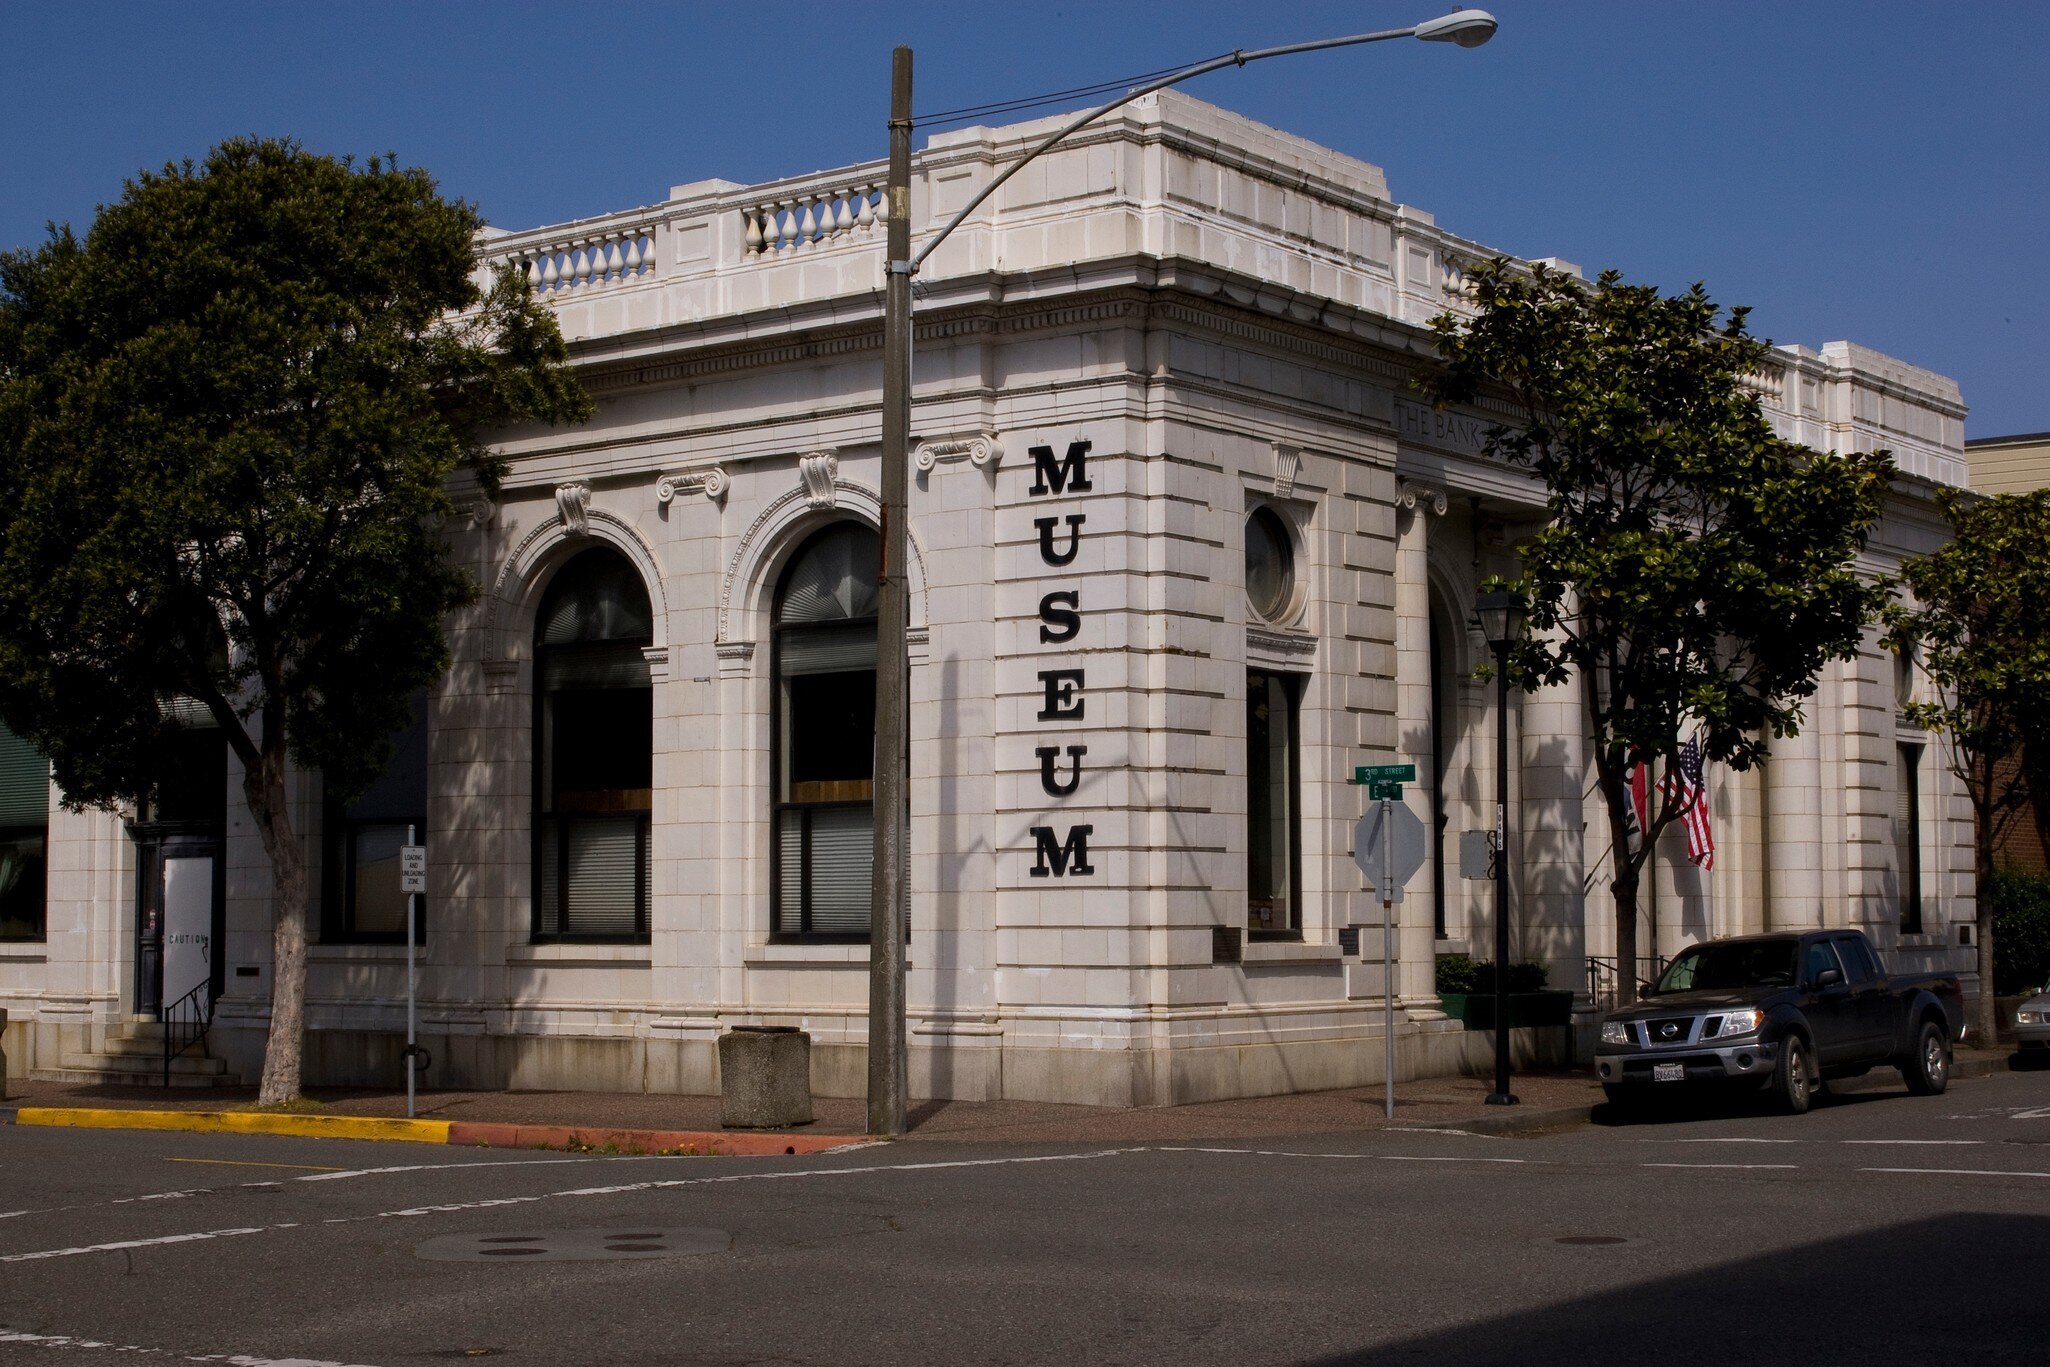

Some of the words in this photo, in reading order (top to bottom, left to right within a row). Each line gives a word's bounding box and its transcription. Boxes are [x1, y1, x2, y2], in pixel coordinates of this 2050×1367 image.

[1394, 403, 1429, 435] THE
[1436, 413, 1480, 448] BANK
[1029, 440, 1094, 878] MUSEUM
[1384, 767, 1405, 775] STREET
[169, 934, 206, 944] CAUTION
